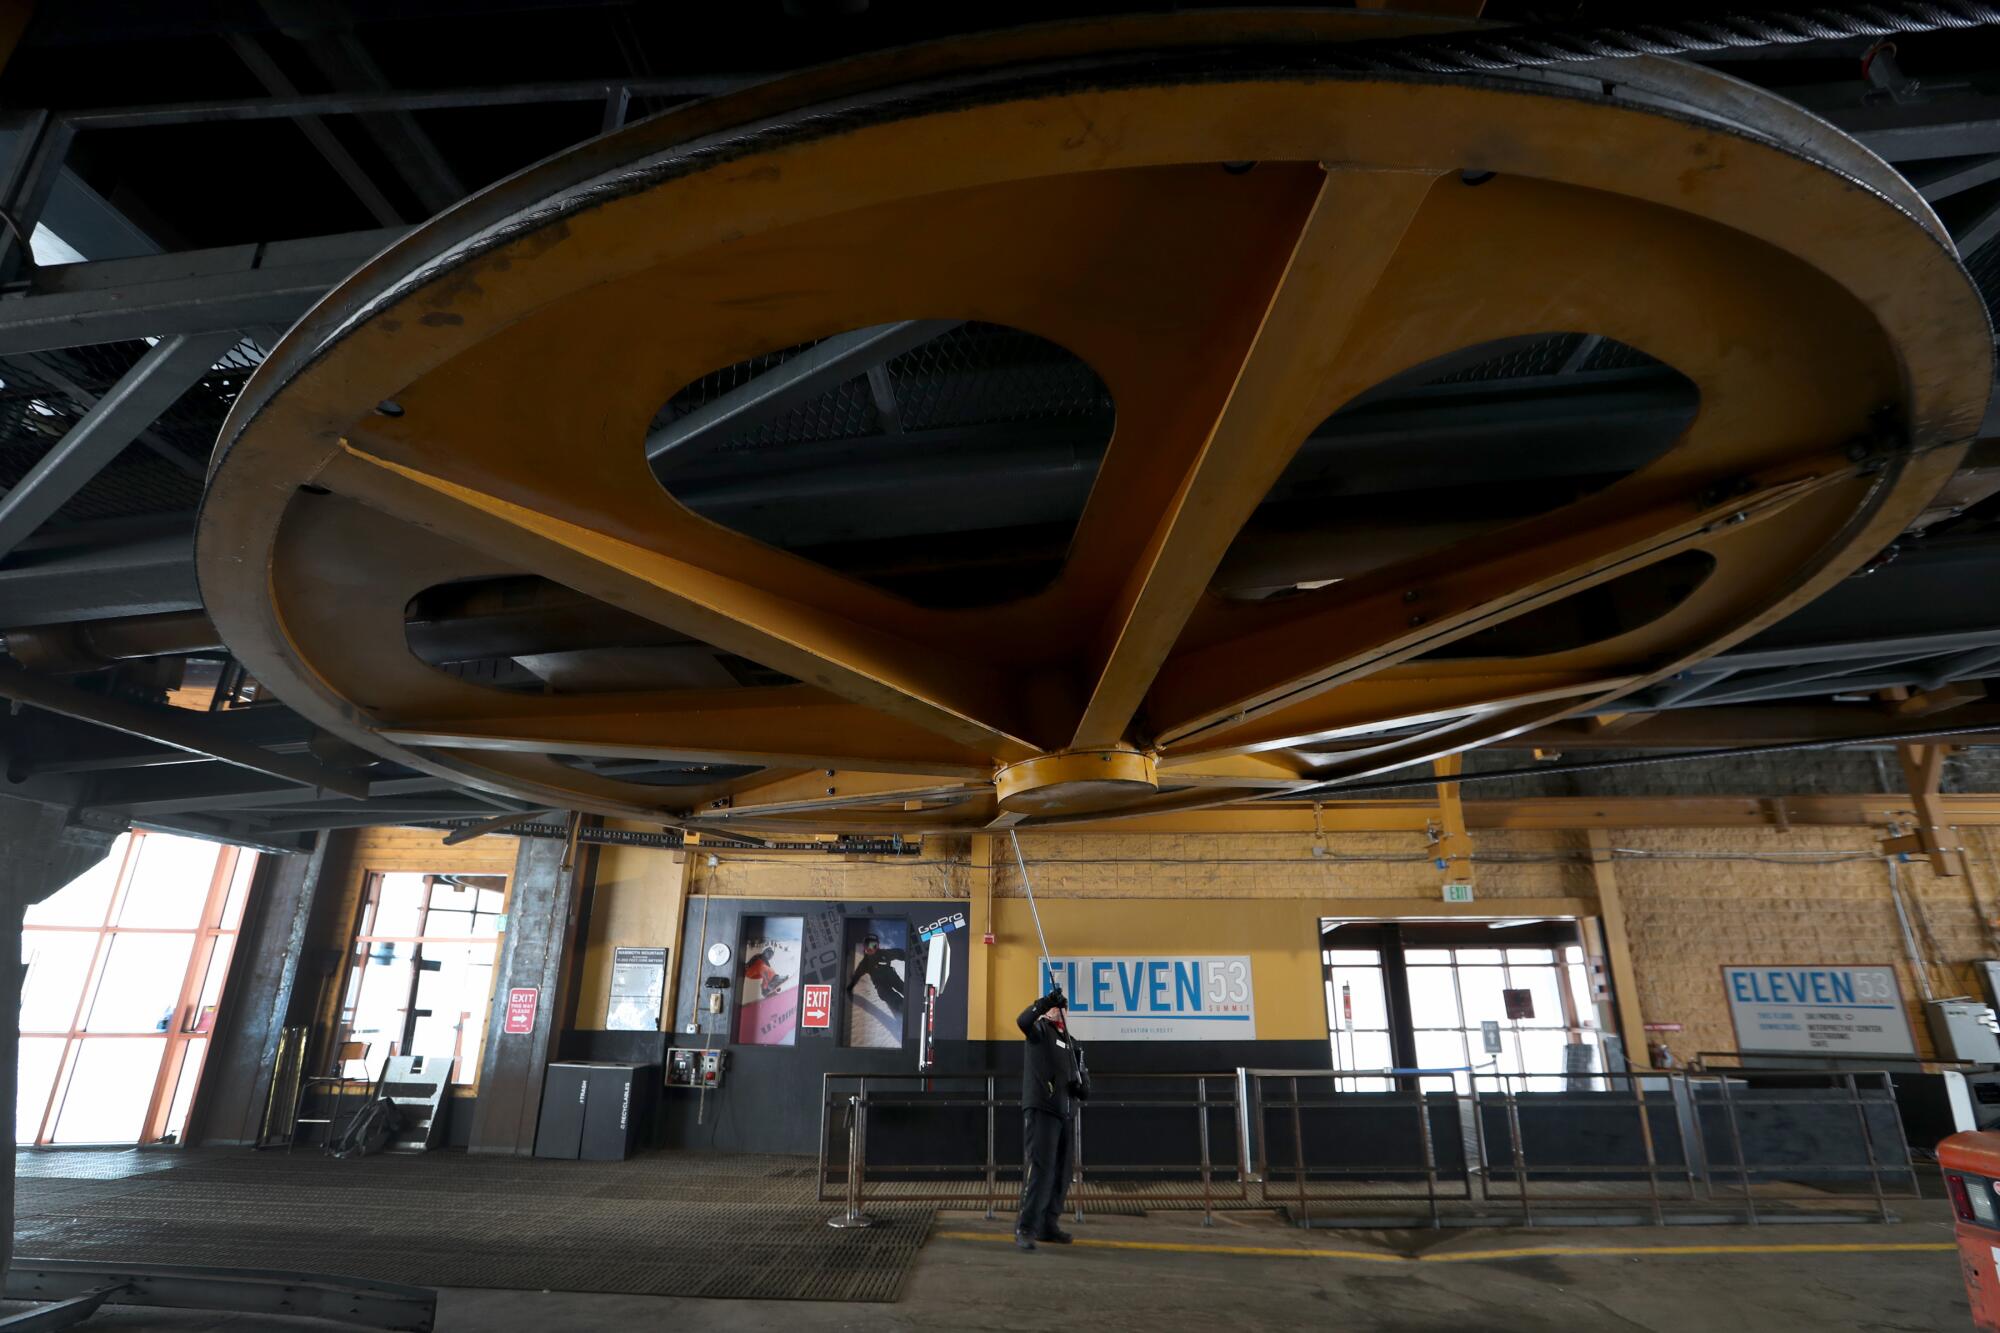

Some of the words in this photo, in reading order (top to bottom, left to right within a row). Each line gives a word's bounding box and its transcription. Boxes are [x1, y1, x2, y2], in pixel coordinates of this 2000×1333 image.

[1449, 886, 1468, 900] EXIT
[918, 912, 963, 934] GoPro
[1731, 971, 1857, 1003] ELEVEN
[511, 993, 535, 1003] EXIT
[806, 991, 829, 1008] EXIT
[1208, 1003, 1250, 1012] SUMMIT
[579, 1080, 588, 1100] TRASH
[620, 1082, 630, 1124] RECYCLABLES
